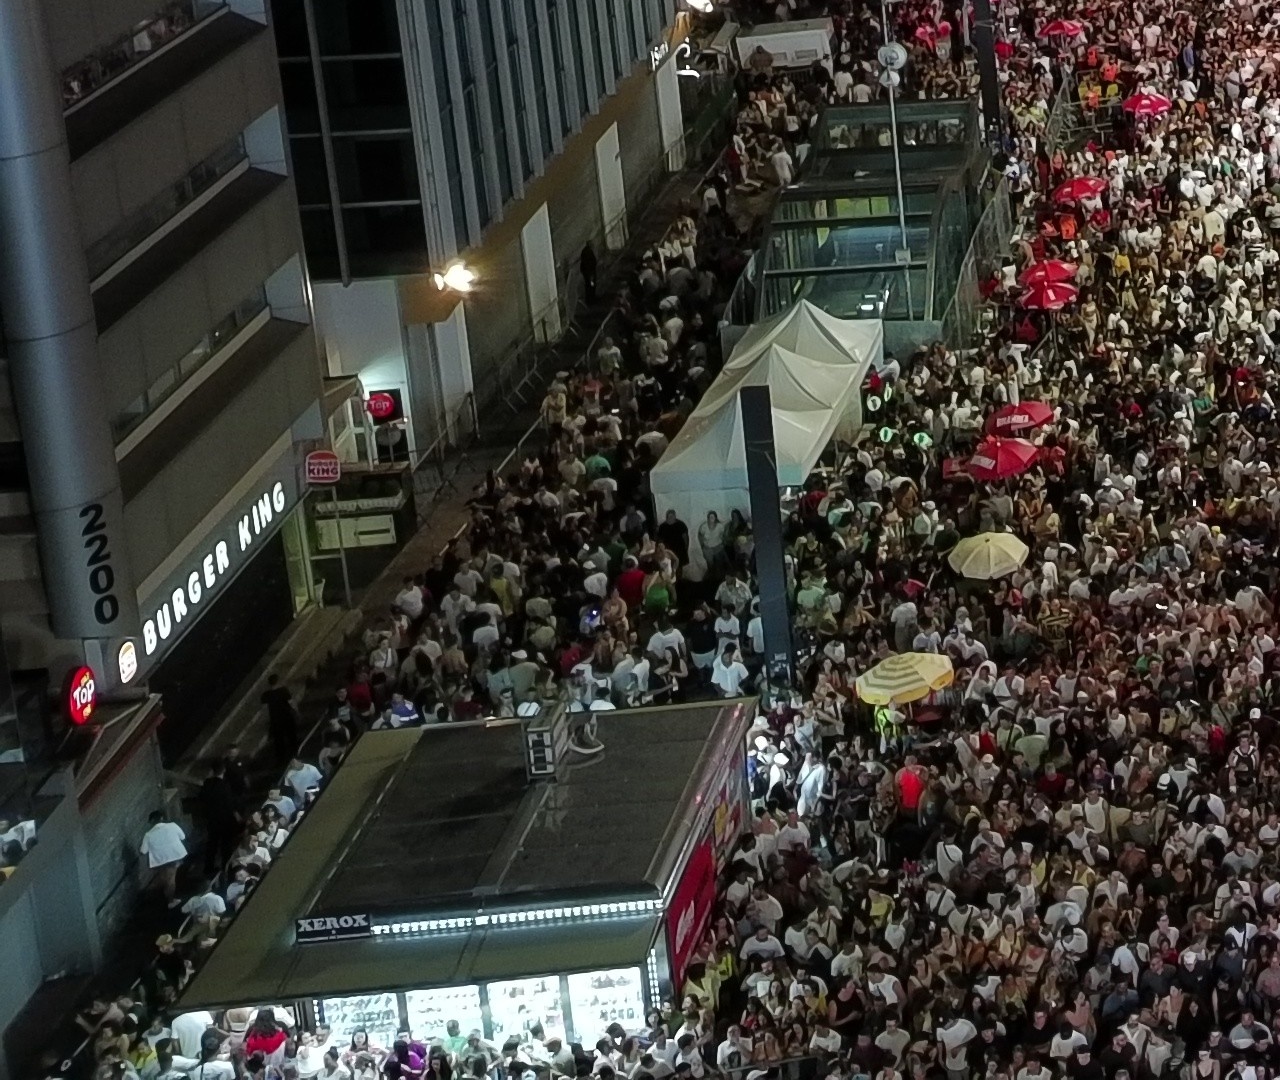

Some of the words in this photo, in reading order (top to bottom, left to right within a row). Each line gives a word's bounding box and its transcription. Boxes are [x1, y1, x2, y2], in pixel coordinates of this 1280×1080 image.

[308, 467, 338, 476] KING
[79, 503, 119, 625] 2200
[142, 540, 230, 656] BURGER
[237, 481, 285, 552] KING
[297, 914, 369, 932] XEROX
